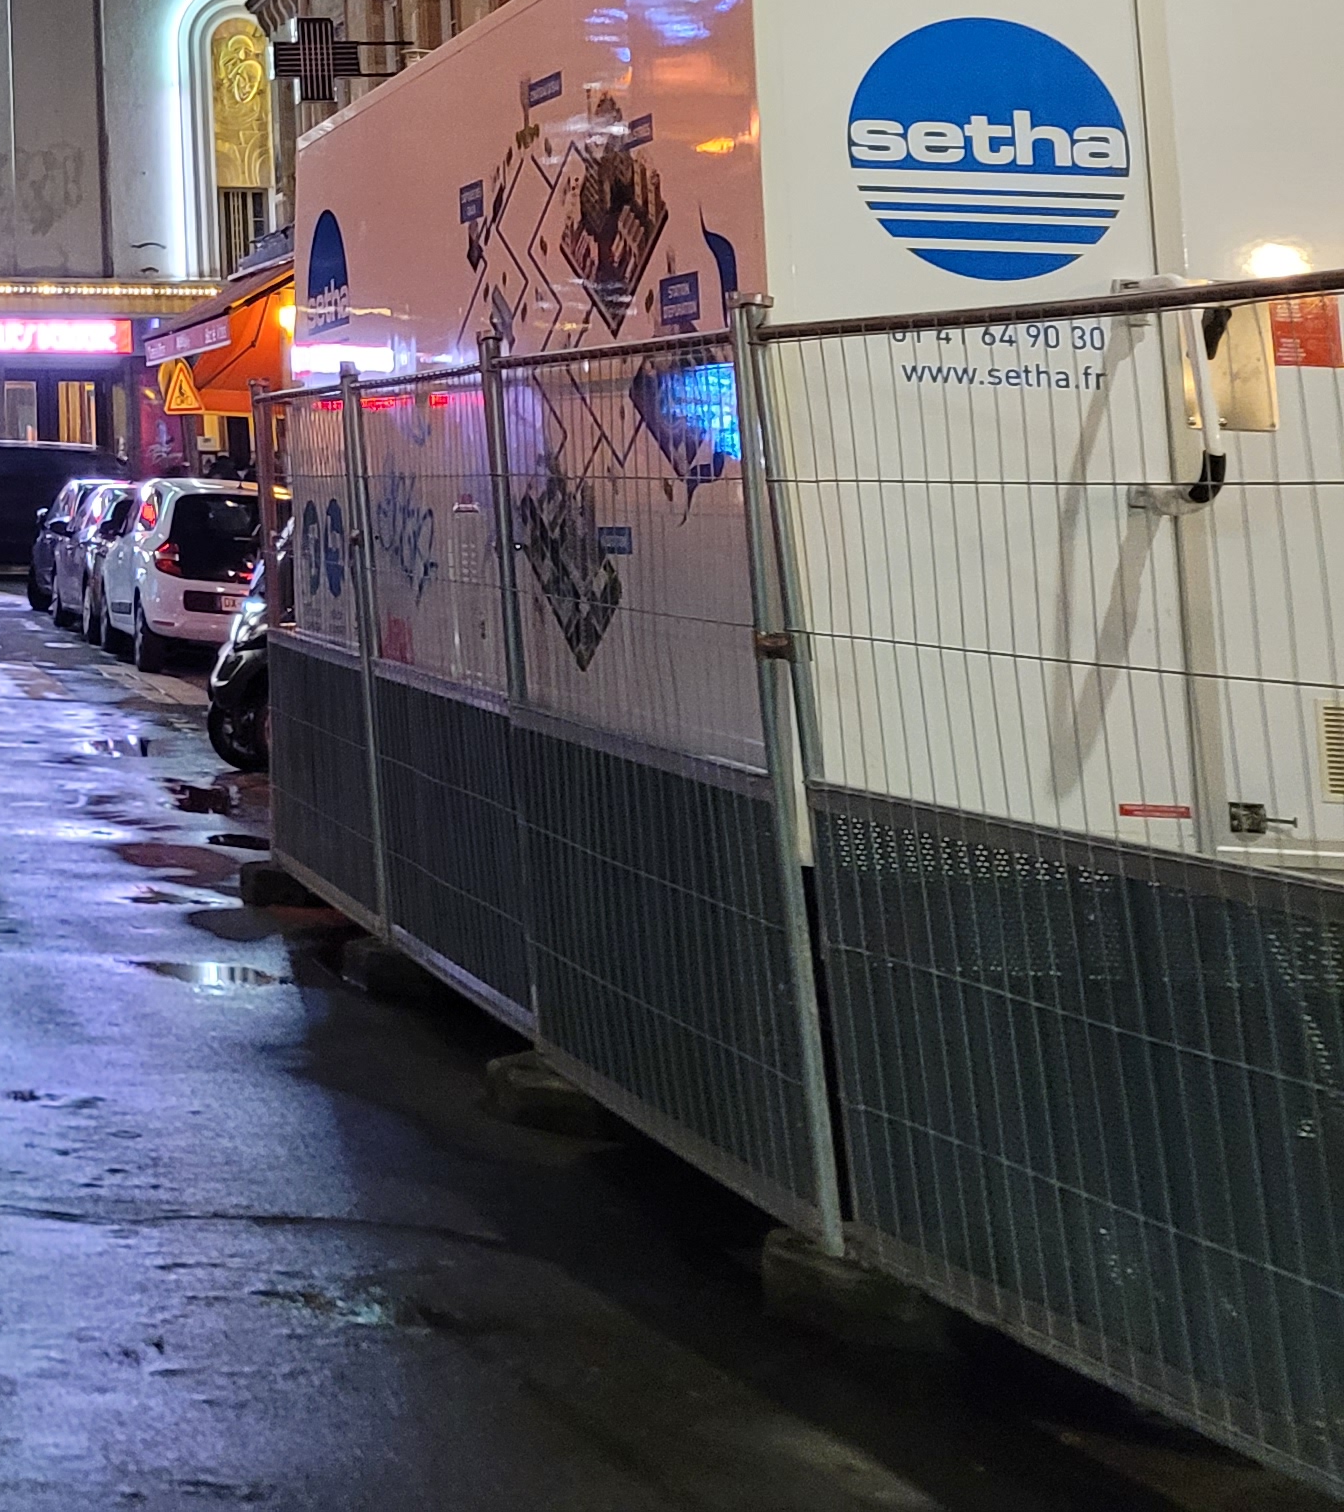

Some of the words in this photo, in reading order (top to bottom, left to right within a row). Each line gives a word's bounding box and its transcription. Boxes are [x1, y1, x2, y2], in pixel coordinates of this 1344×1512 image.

[850, 109, 1126, 169] setha
[307, 278, 349, 329] setha
[981, 324, 1016, 348] 64
[1026, 324, 1060, 349] 90
[1072, 325, 1105, 351] 30
[901, 363, 1107, 391] www.setha.fr
